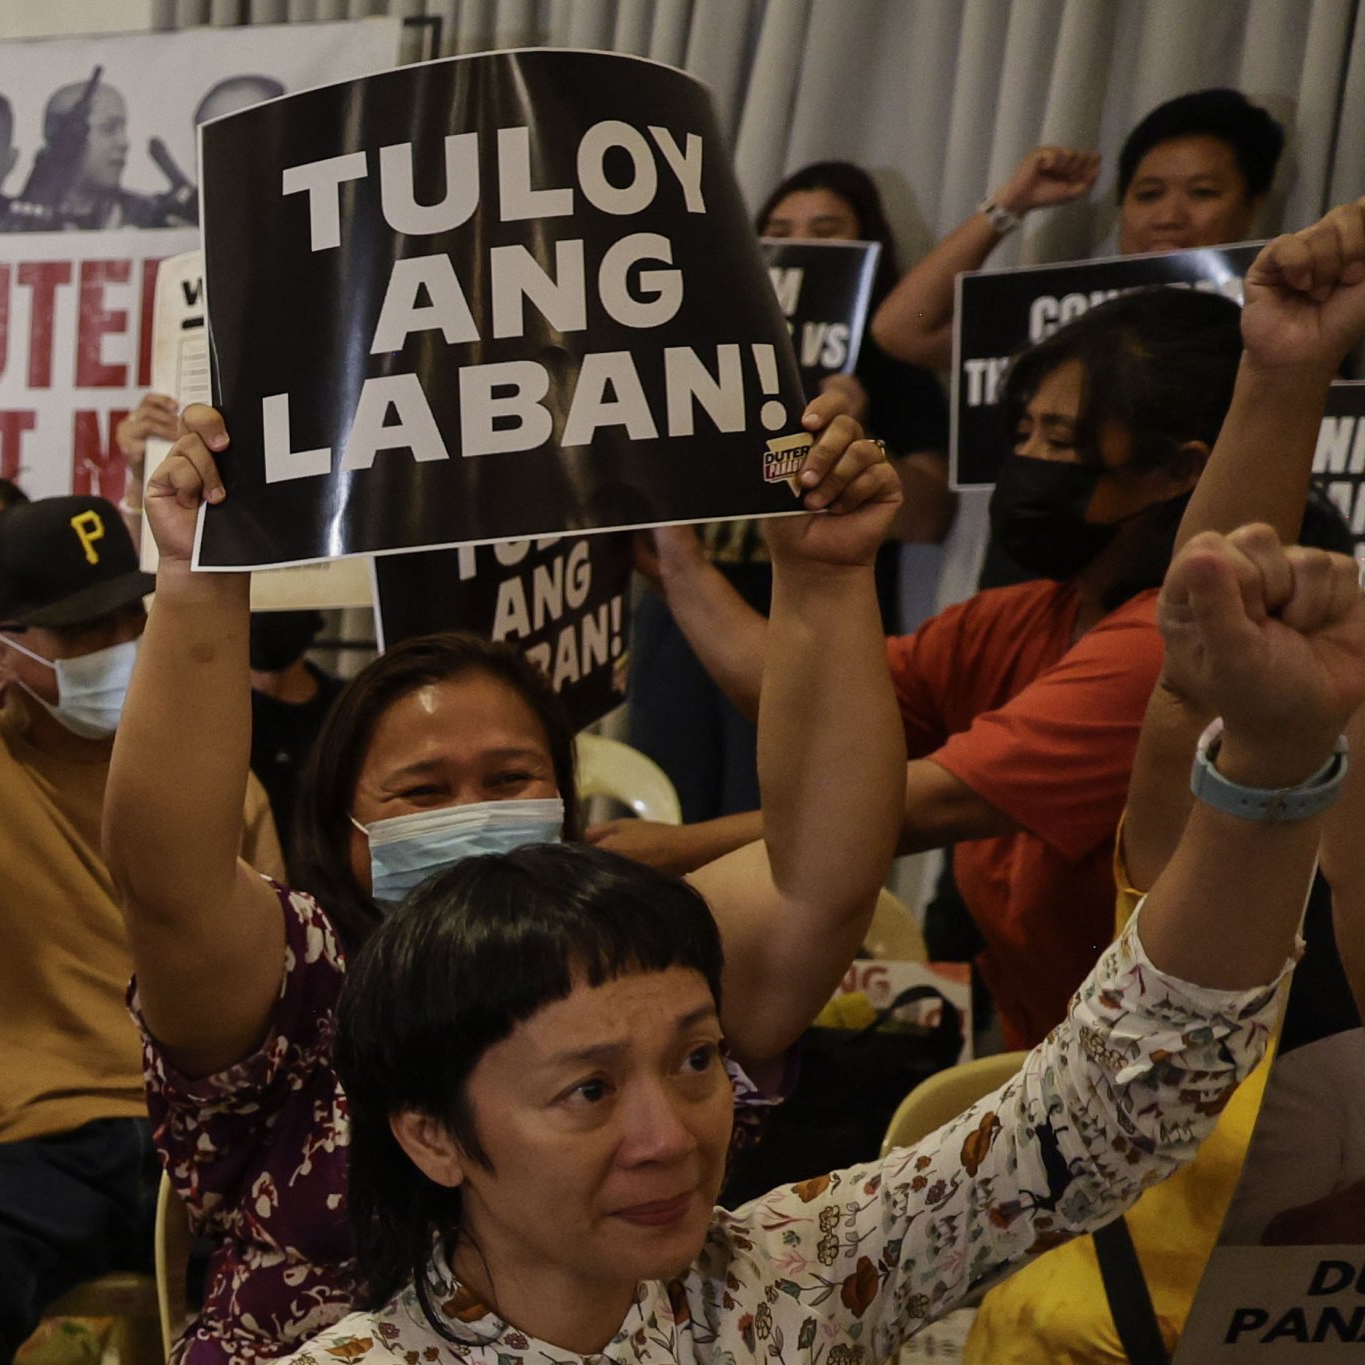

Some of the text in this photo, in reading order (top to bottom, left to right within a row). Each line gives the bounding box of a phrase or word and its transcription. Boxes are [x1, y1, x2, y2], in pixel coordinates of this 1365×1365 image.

[282, 120, 706, 252] TULOY
[370, 232, 683, 355] ANG
[802, 321, 849, 369] VS
[262, 343, 788, 484] LABAN!
[765, 446, 810, 465] DUTER
[71, 510, 105, 565] P
[492, 540, 591, 643] ANG
